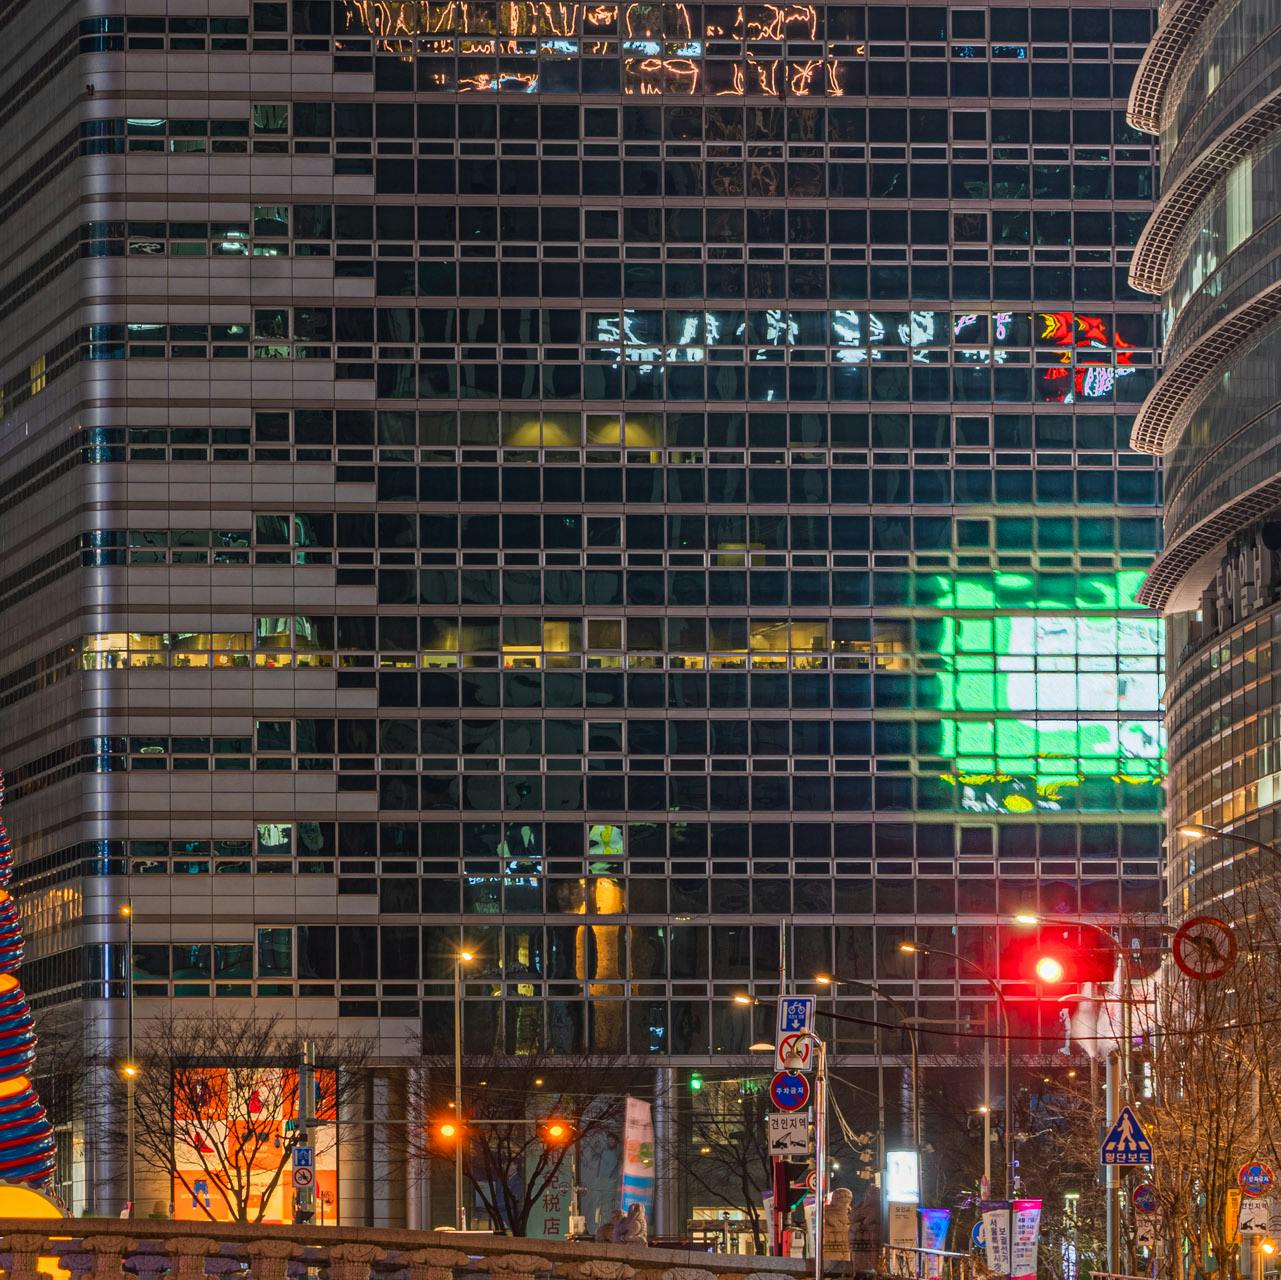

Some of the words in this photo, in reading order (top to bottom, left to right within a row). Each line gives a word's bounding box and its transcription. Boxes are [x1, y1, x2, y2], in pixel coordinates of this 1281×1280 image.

[776, 1087, 804, 1095] 주차금지
[771, 1117, 807, 1130] 견인지역
[1105, 1152, 1151, 1163] 횡단보도
